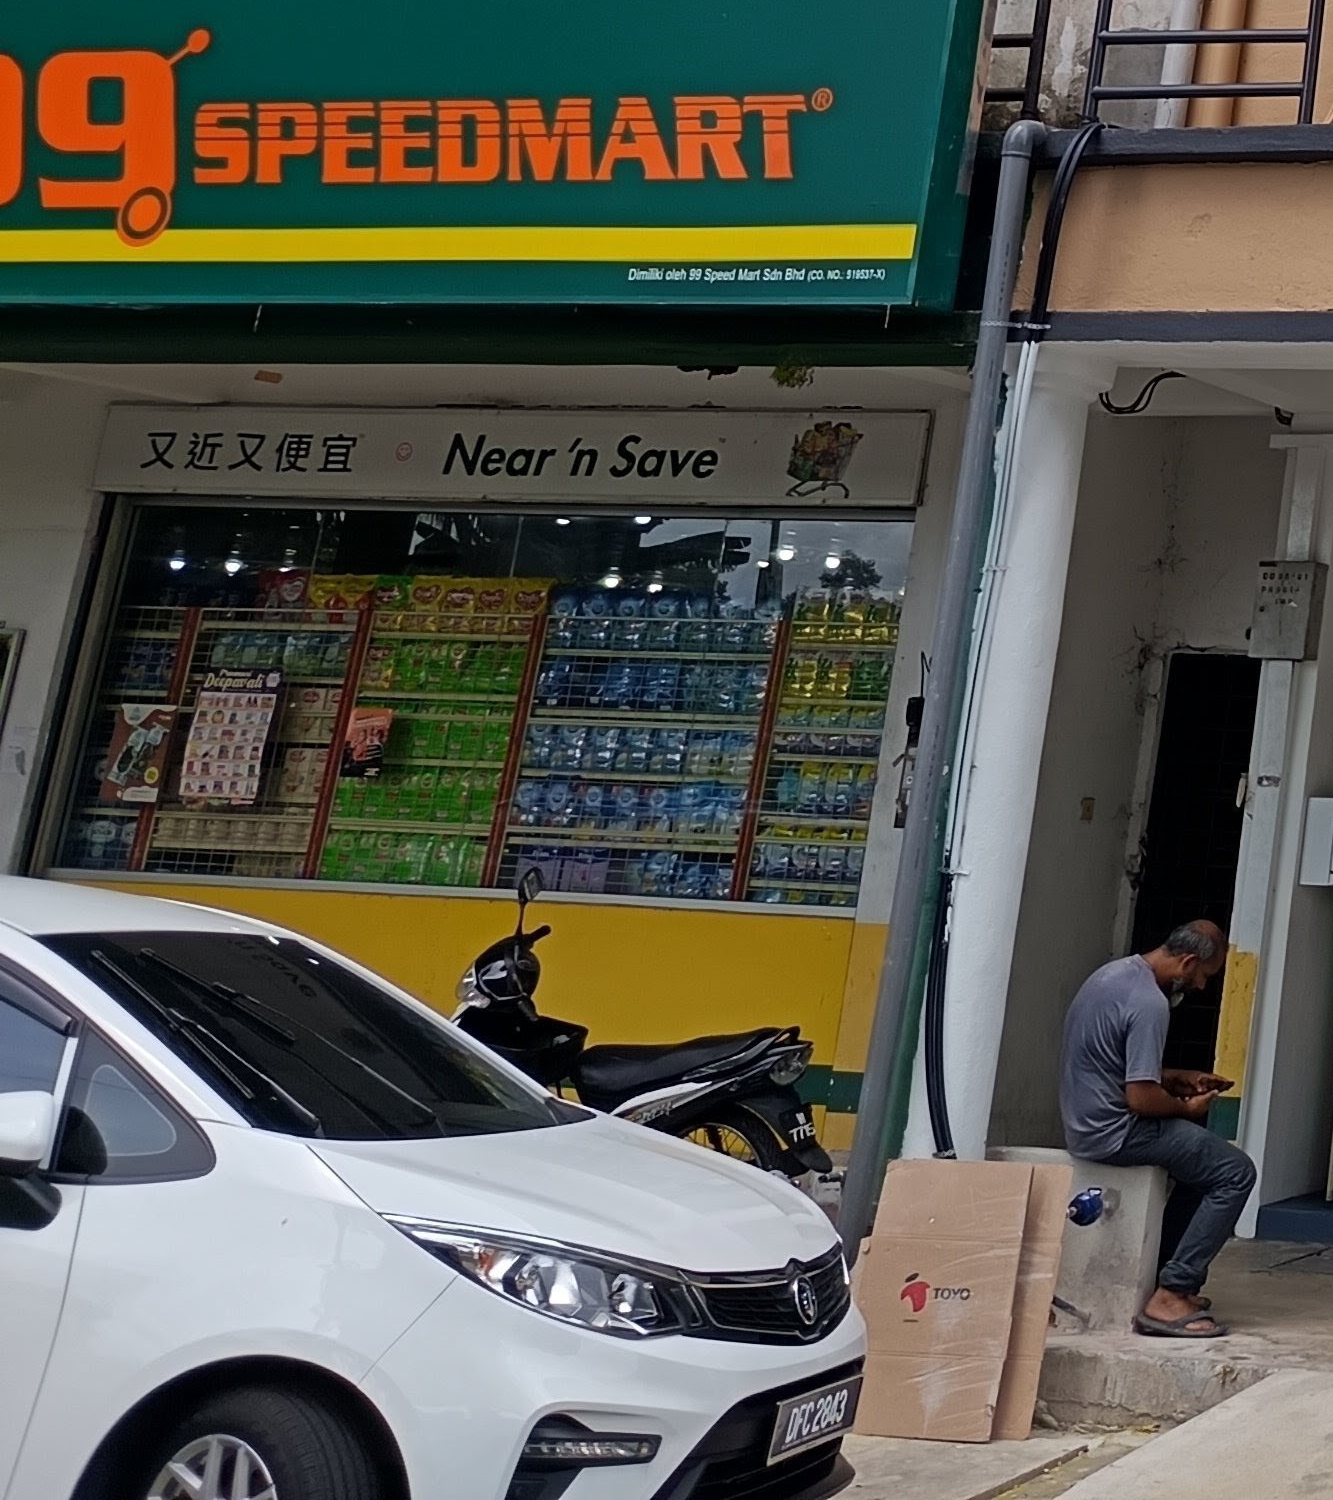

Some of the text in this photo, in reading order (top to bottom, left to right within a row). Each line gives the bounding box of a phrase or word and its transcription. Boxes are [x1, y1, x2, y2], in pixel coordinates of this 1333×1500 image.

[628, 268, 665, 281] Dimiliki
[665, 267, 687, 280] oleh
[689, 267, 702, 280] 99
[703, 268, 737, 283] Speed
[737, 268, 760, 281] Mart
[762, 268, 783, 281] Sdn
[784, 268, 805, 281] Bhd
[139, 431, 358, 474] 又近又便宜
[442, 433, 557, 477] Near
[608, 434, 720, 480] Save
[203, 672, 265, 692] Deepavali
[933, 1287, 971, 1301] TOYO
[784, 1388, 849, 1444] DFC 2843
